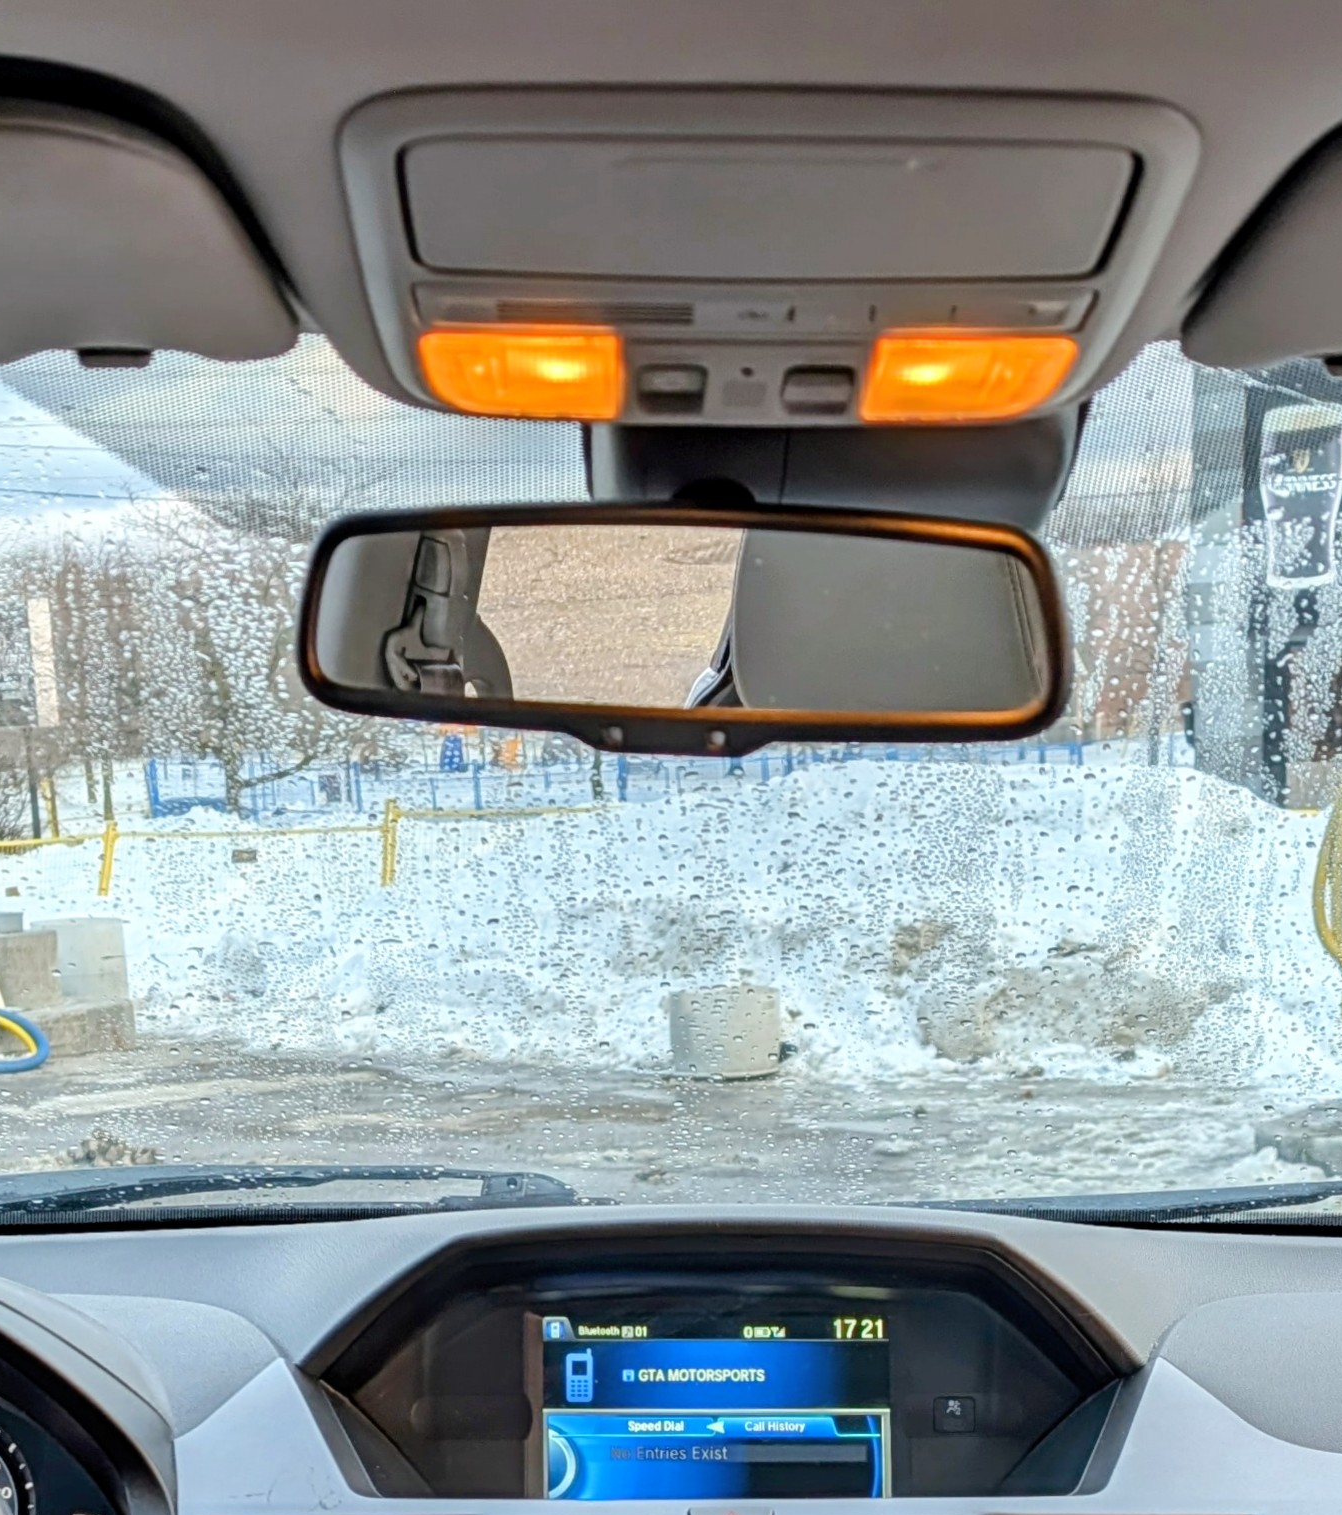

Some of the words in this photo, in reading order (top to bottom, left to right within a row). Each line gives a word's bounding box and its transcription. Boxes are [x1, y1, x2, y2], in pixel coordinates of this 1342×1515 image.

[578, 1326, 620, 1337] Bluetooth
[635, 1327, 647, 1338] 01
[638, 1368, 665, 1382] GTA
[668, 1368, 765, 1382] MOTORSPORTS
[627, 1420, 661, 1433] Speed
[664, 1420, 684, 1432] Dial
[744, 1420, 764, 1432] Call
[767, 1420, 805, 1434] History
[637, 1446, 687, 1460] Entries
[692, 1446, 728, 1460] Exist
